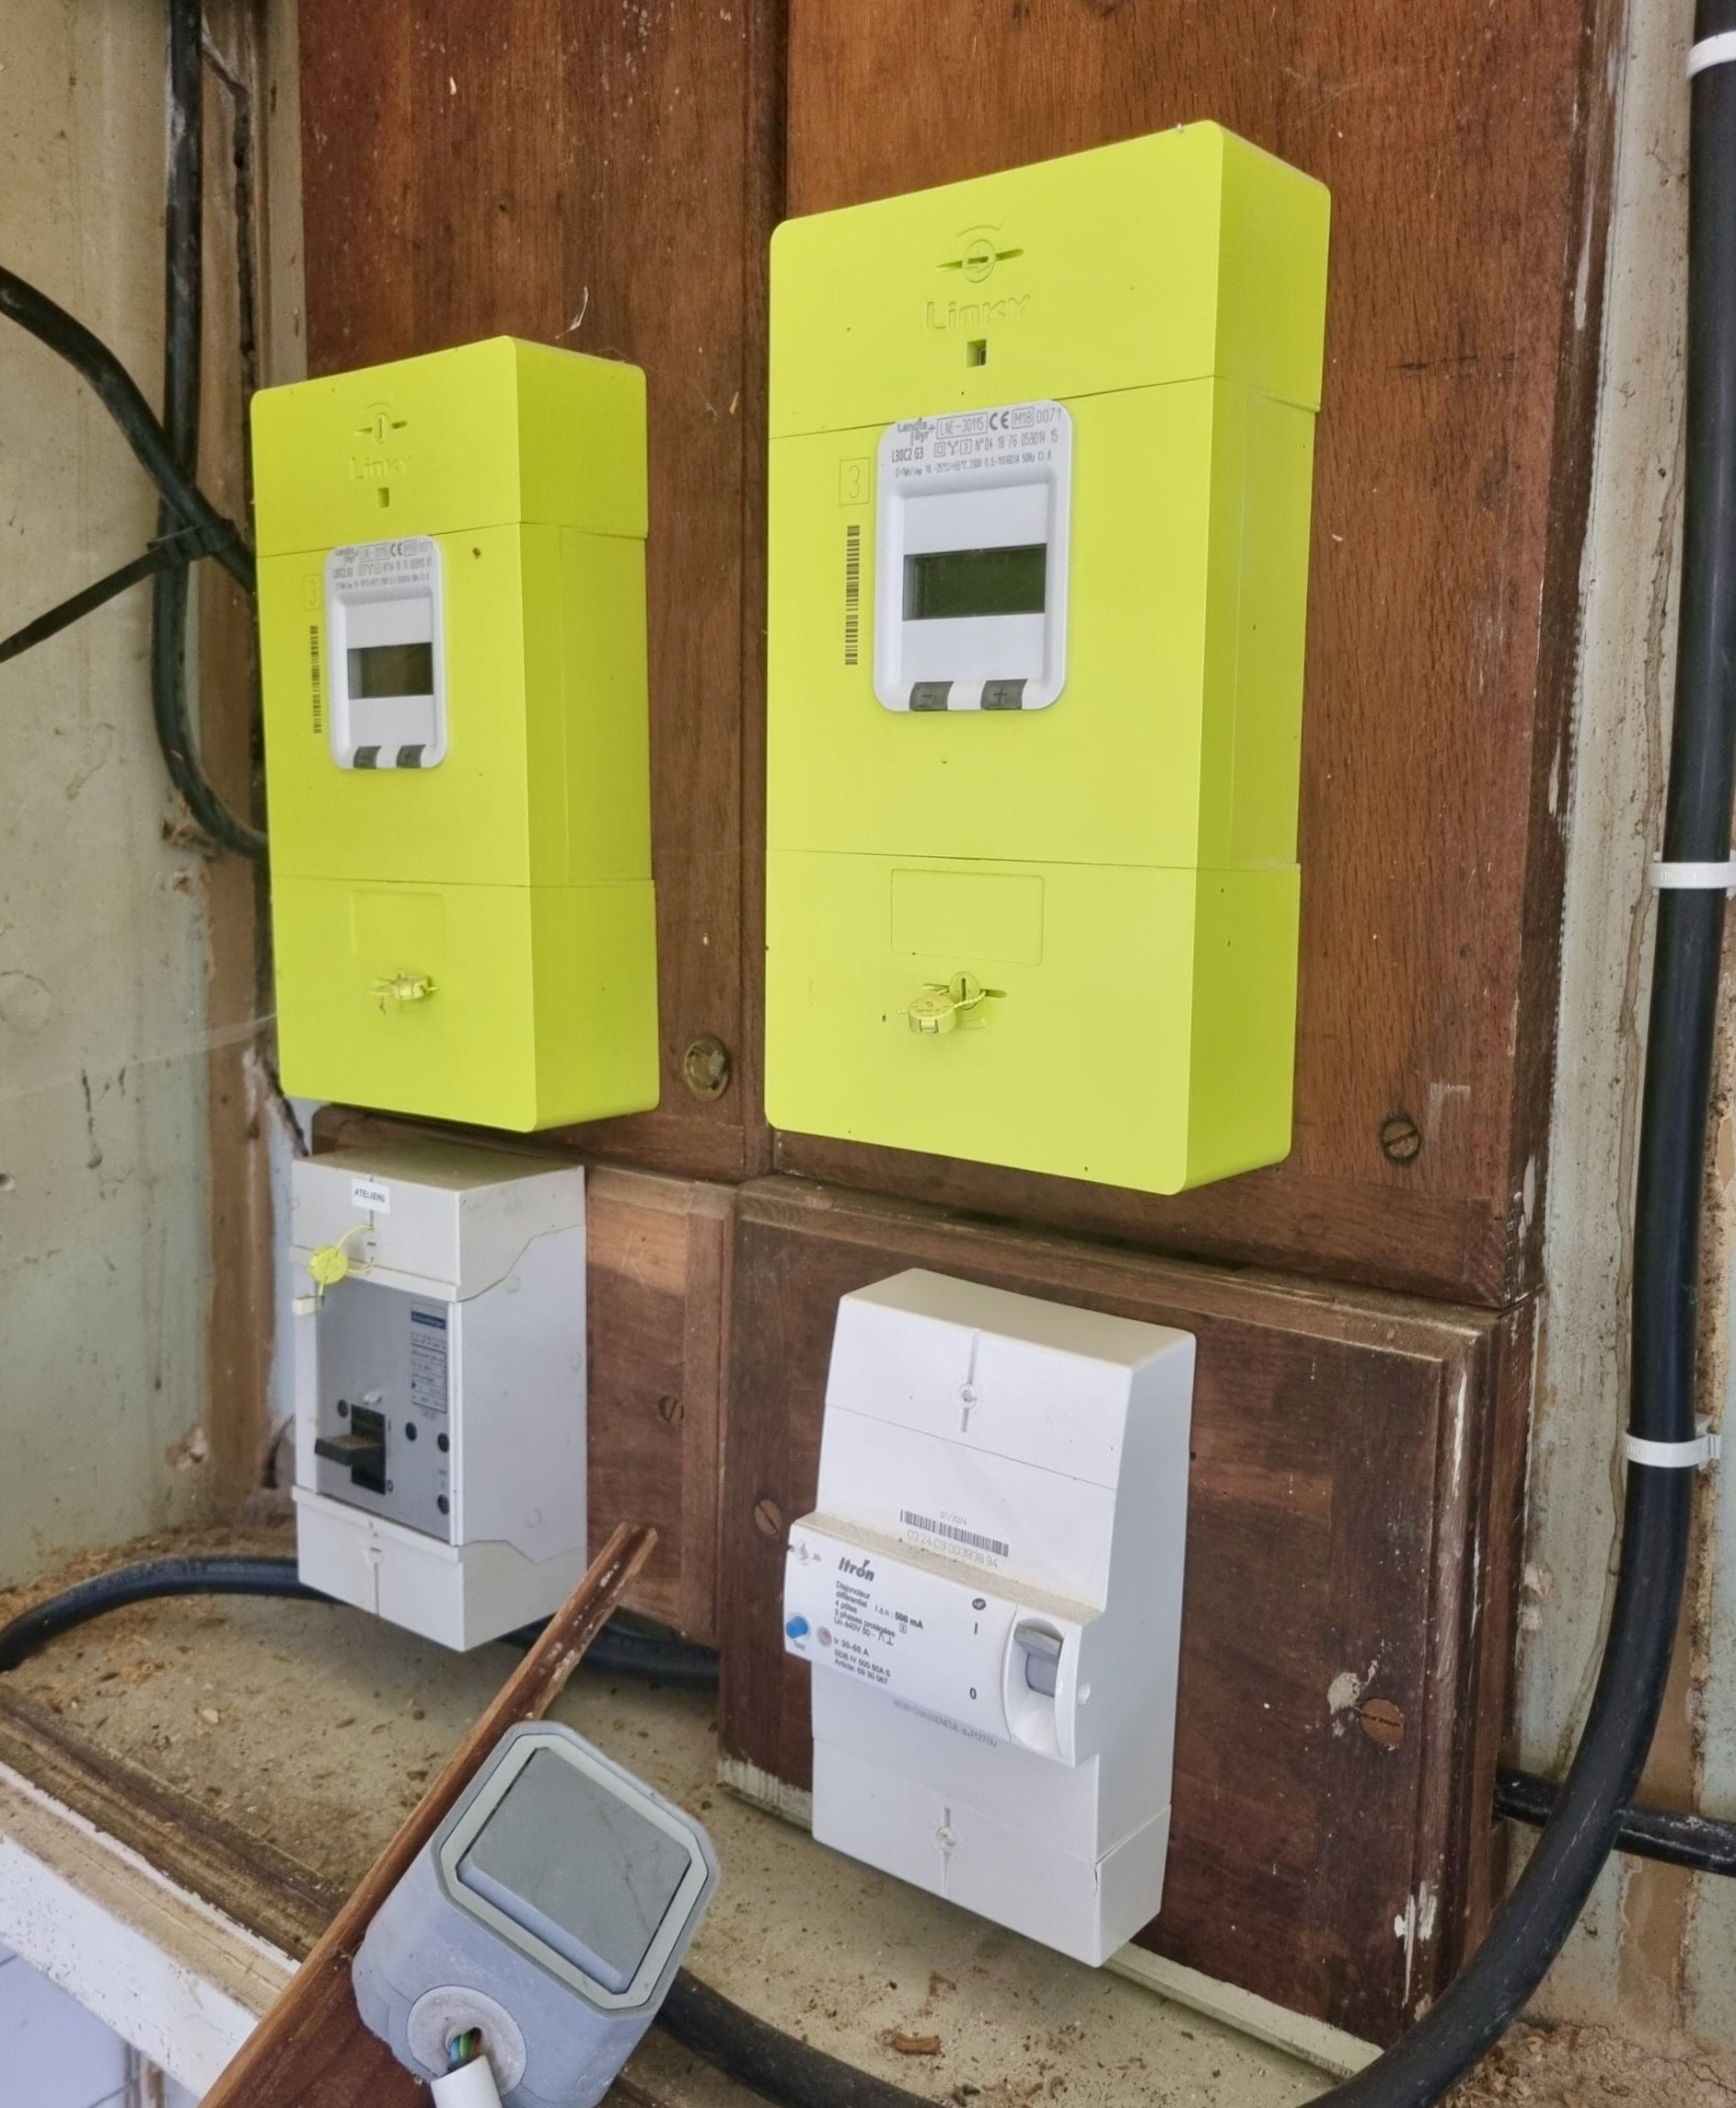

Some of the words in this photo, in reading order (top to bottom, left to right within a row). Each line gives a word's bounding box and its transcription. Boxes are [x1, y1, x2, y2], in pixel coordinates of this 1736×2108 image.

[990, 411, 1010, 430] CE
[1036, 408, 1061, 424] 0071
[909, 1618, 923, 1630] mA
